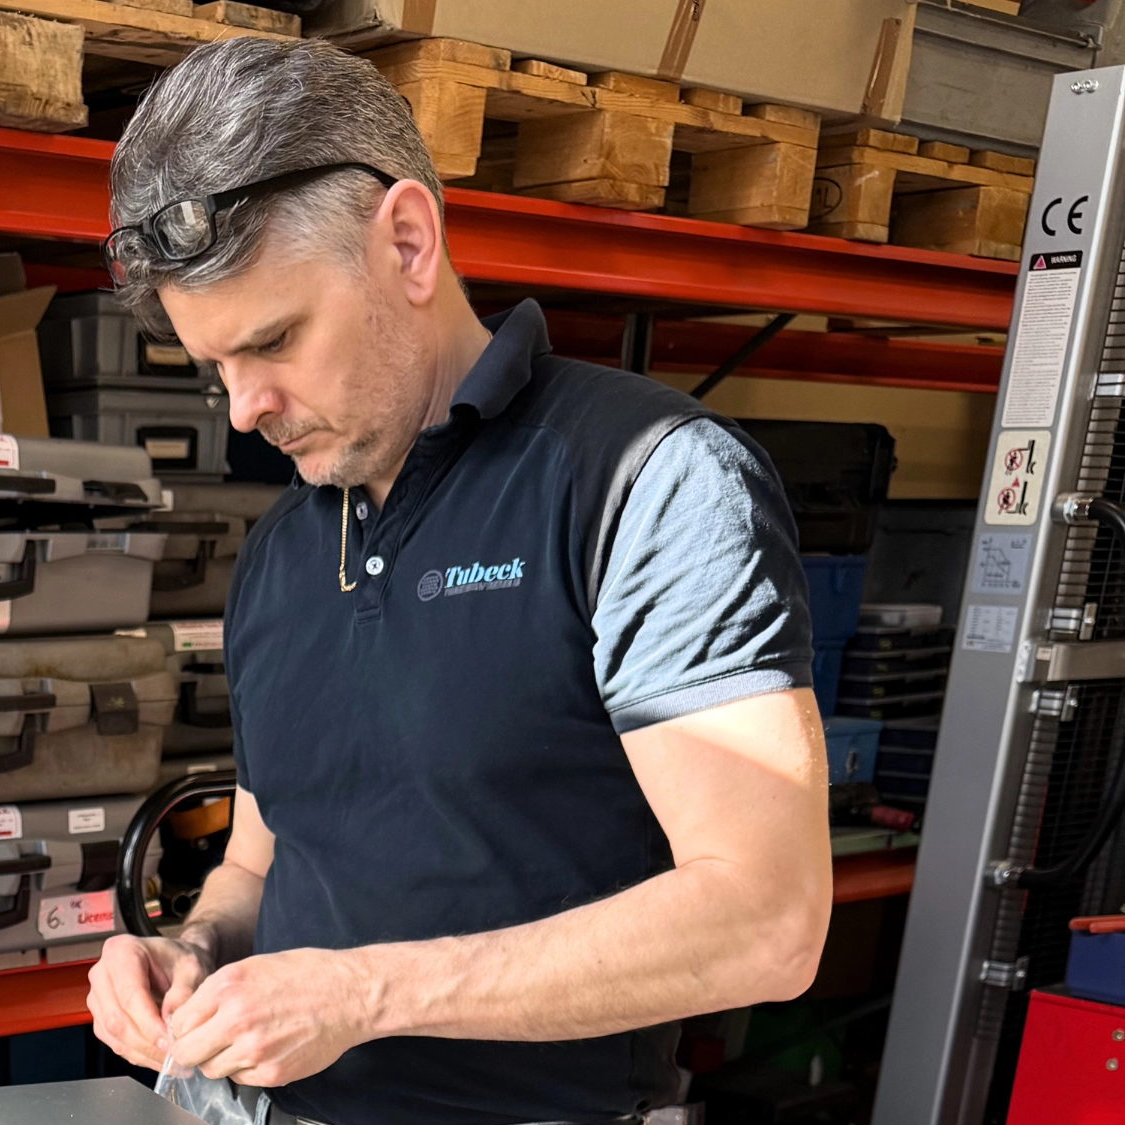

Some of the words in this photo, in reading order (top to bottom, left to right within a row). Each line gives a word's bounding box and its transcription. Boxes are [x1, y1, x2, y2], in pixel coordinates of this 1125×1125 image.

[1041, 195, 1089, 237] CE
[1050, 254, 1077, 264] WARNING
[444, 556, 526, 589] Tubeck
